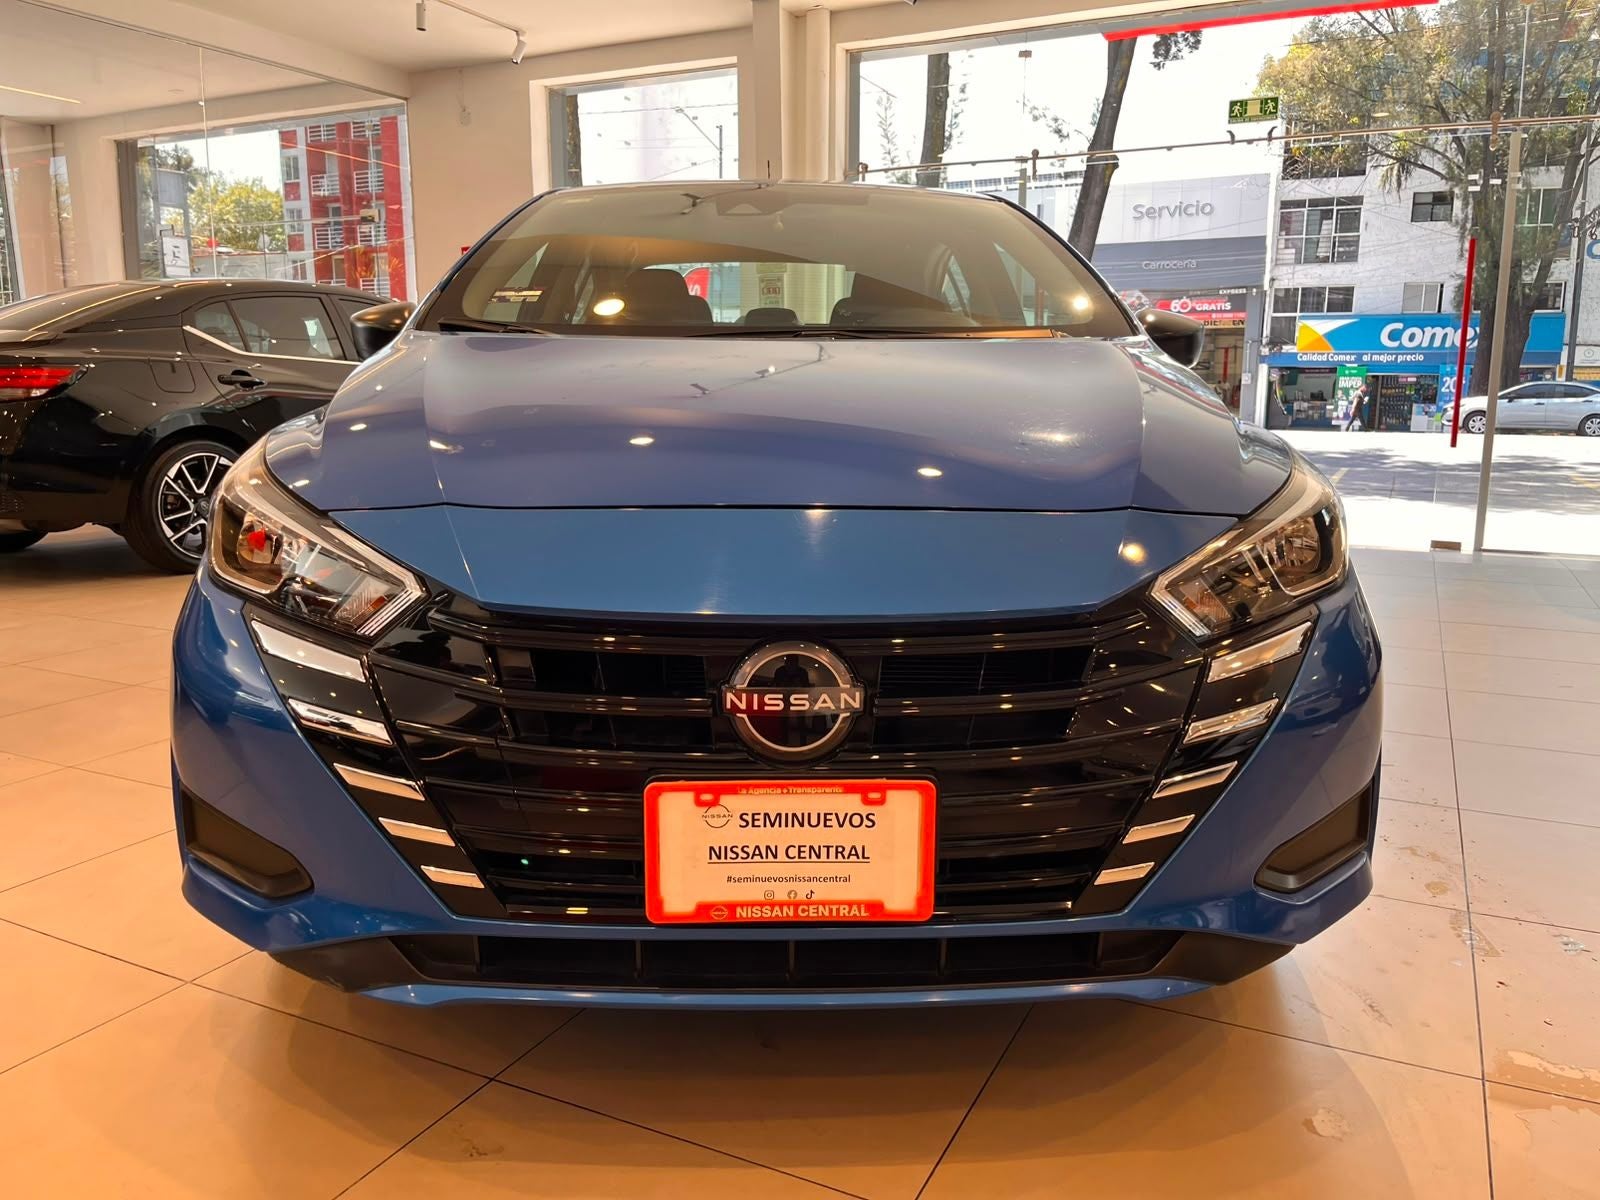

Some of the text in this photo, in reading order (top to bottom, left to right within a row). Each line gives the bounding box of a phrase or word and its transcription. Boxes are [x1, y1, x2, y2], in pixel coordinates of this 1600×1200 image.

[1132, 200, 1215, 221] Servicio
[1195, 302, 1232, 311] GRATIS
[1297, 353, 1424, 363] Calidad Comex al mejor precio
[725, 691, 861, 711] NISSAN
[738, 812, 876, 829] SEMINUEVOS
[708, 844, 871, 861] NISSAN CENTRAL
[726, 873, 851, 884] #seminuevosnissancentral
[735, 904, 869, 918] NISSAN CENTRAL
